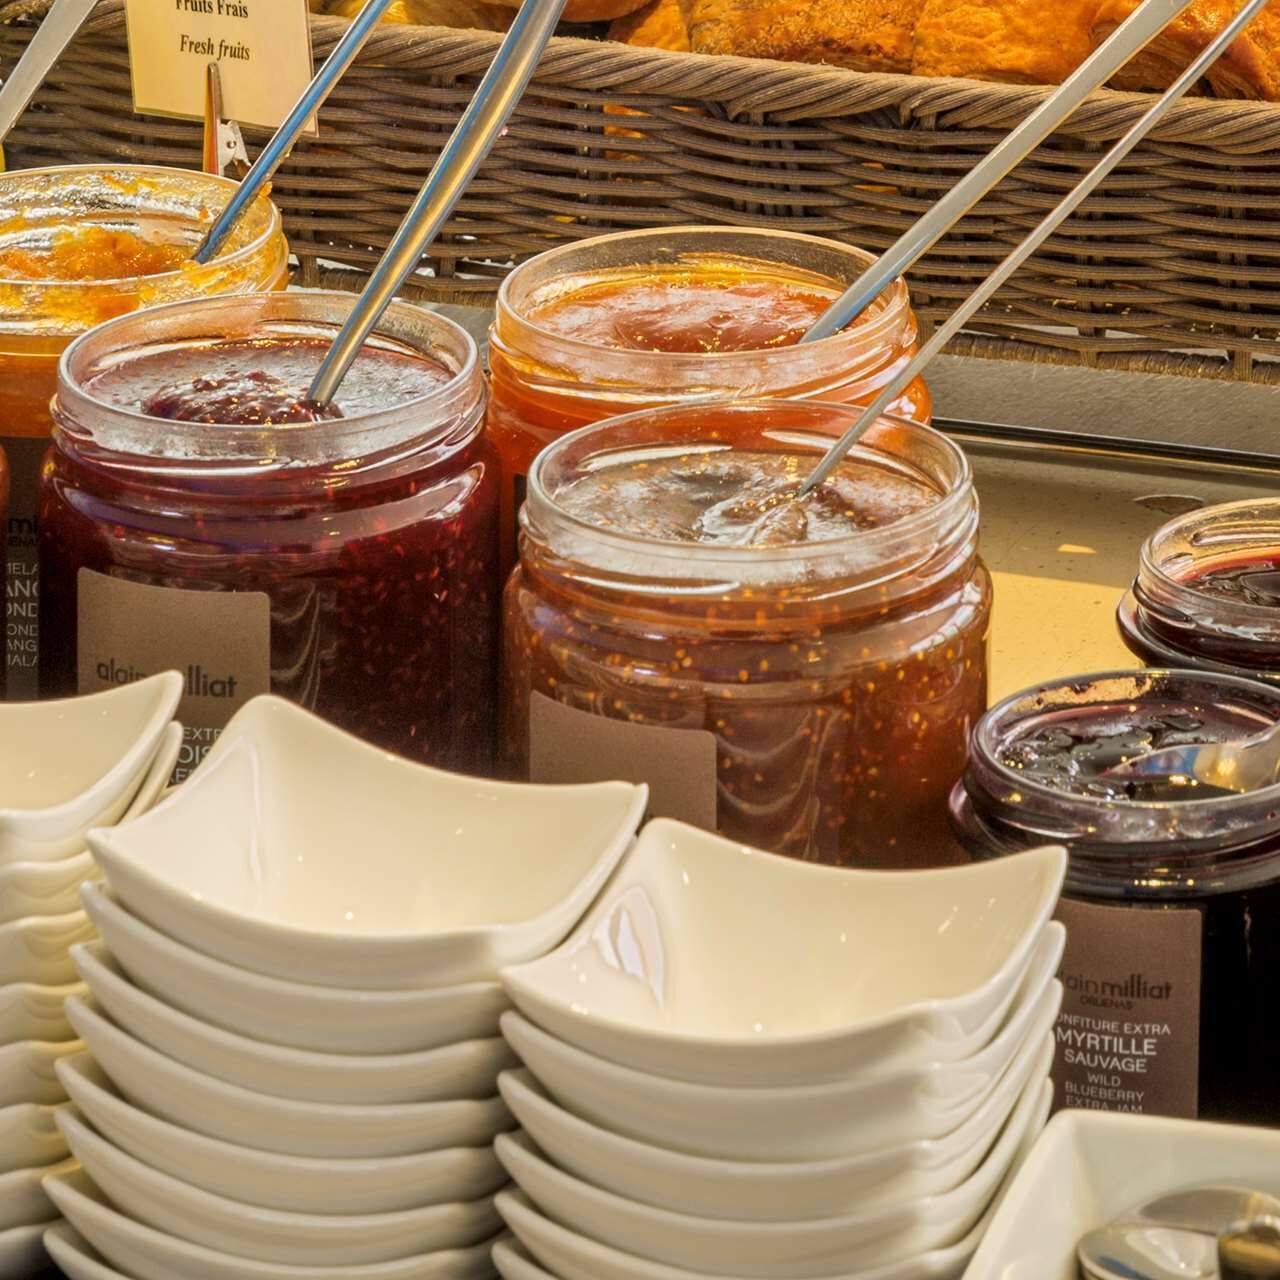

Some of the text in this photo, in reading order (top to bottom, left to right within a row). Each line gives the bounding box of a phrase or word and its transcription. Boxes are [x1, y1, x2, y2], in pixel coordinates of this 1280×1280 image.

[180, 34, 251, 62] Fresh fruits
[1064, 972, 1172, 1001] ainmilliat
[1057, 1013, 1172, 1036] ONFITURE EXTRA
[1056, 1026, 1158, 1056] MYRTILLE
[1064, 1048, 1148, 1073] SAUVAGE
[1064, 1080, 1145, 1102] BLUEBERRY
[1086, 1072, 1121, 1088] WILD
